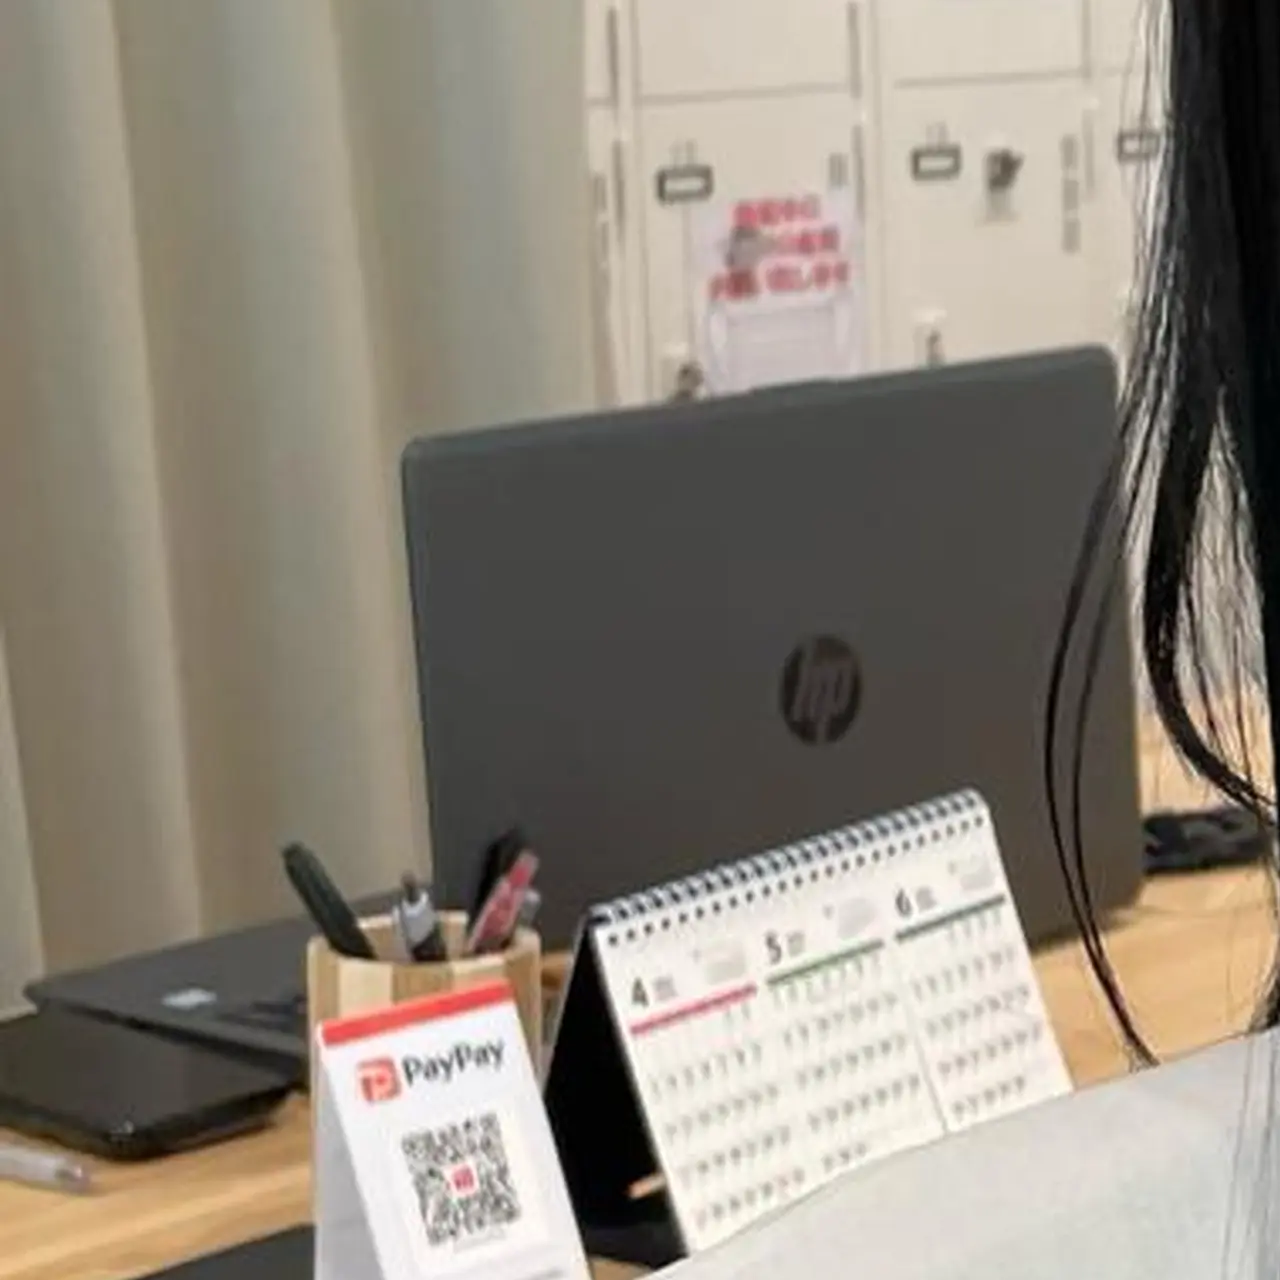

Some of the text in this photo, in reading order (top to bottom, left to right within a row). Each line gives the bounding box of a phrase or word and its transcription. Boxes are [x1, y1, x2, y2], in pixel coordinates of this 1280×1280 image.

[895, 888, 913, 918] 6
[766, 931, 782, 965] 5
[631, 977, 649, 1008] 4
[401, 1038, 505, 1087] PayPay
